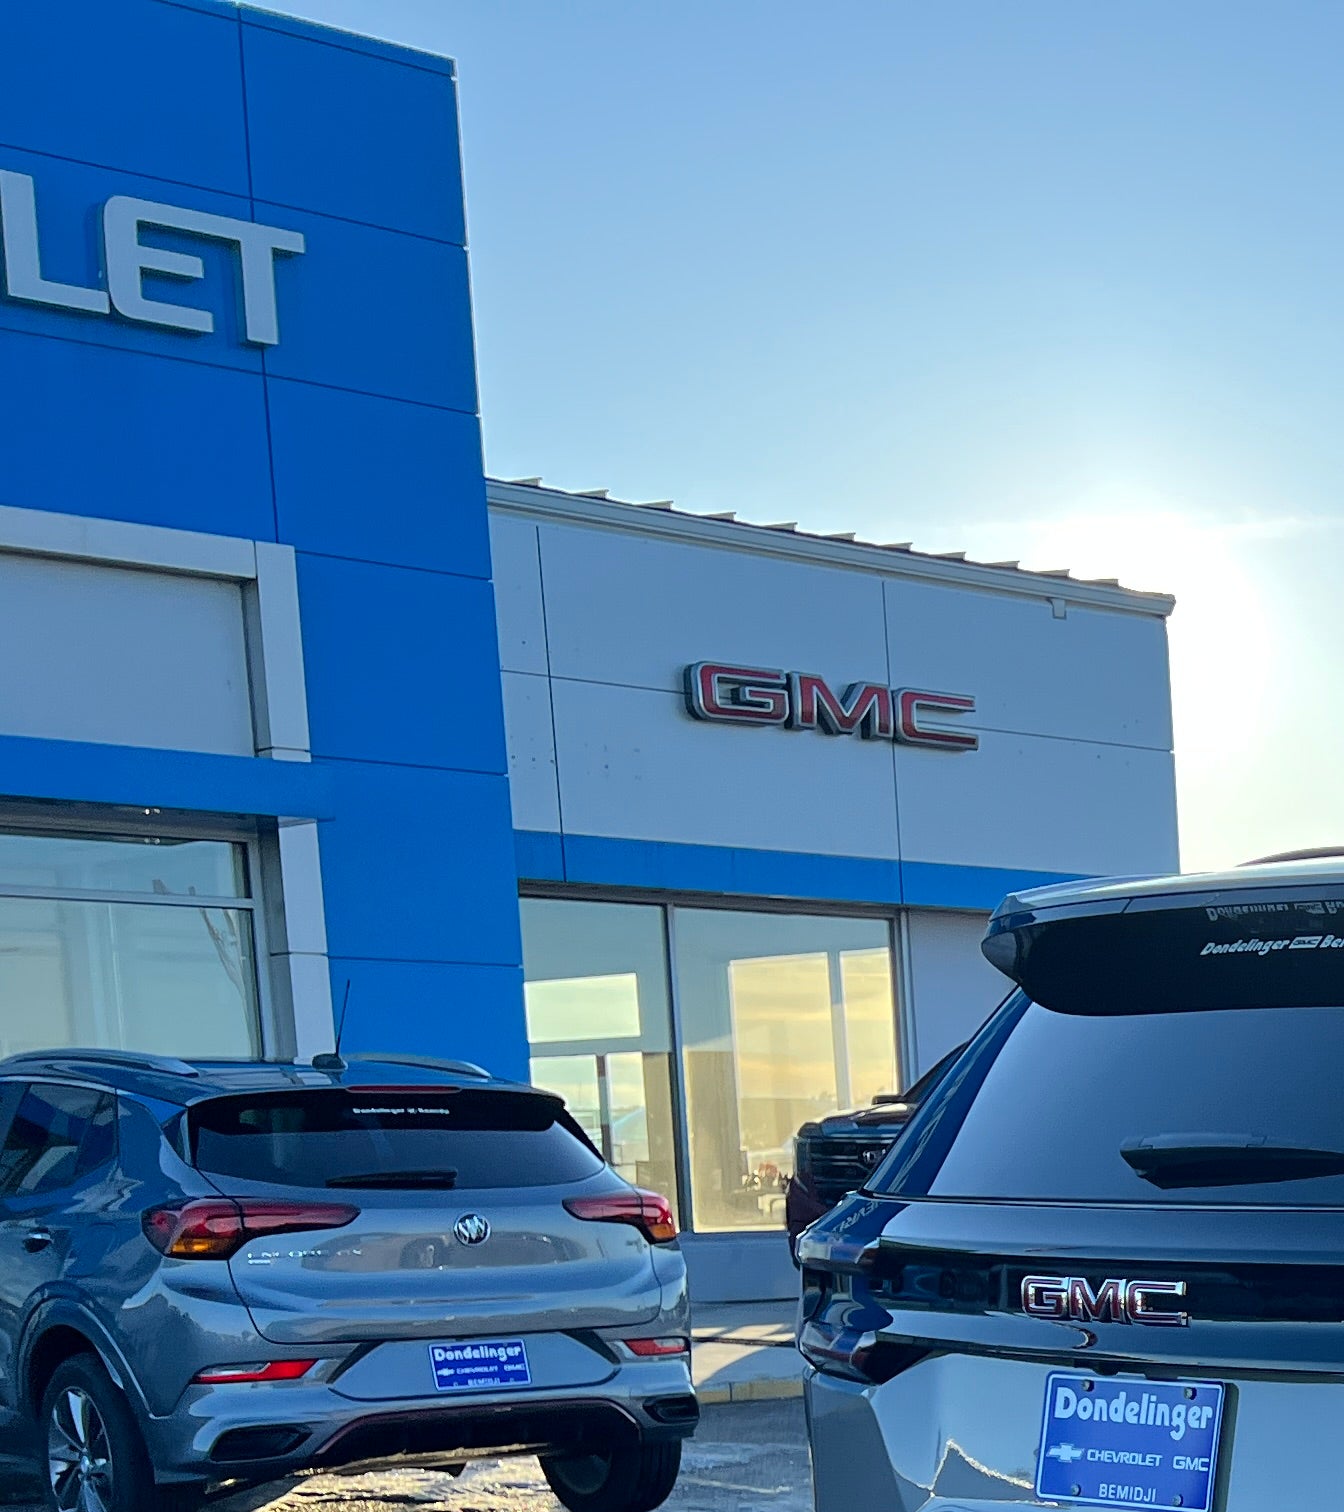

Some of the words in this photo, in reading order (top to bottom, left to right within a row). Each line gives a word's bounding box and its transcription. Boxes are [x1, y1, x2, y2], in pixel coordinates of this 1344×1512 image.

[0, 168, 306, 346] LET
[683, 660, 980, 751] GMC
[1021, 1275, 1192, 1327] GMC
[433, 1345, 522, 1362] Dondelinger
[1054, 1386, 1213, 1441] Dondelinger
[1086, 1448, 1163, 1467] CHEVROLET
[1172, 1455, 1210, 1472] GMC
[1098, 1483, 1157, 1503] BEMIDJI
